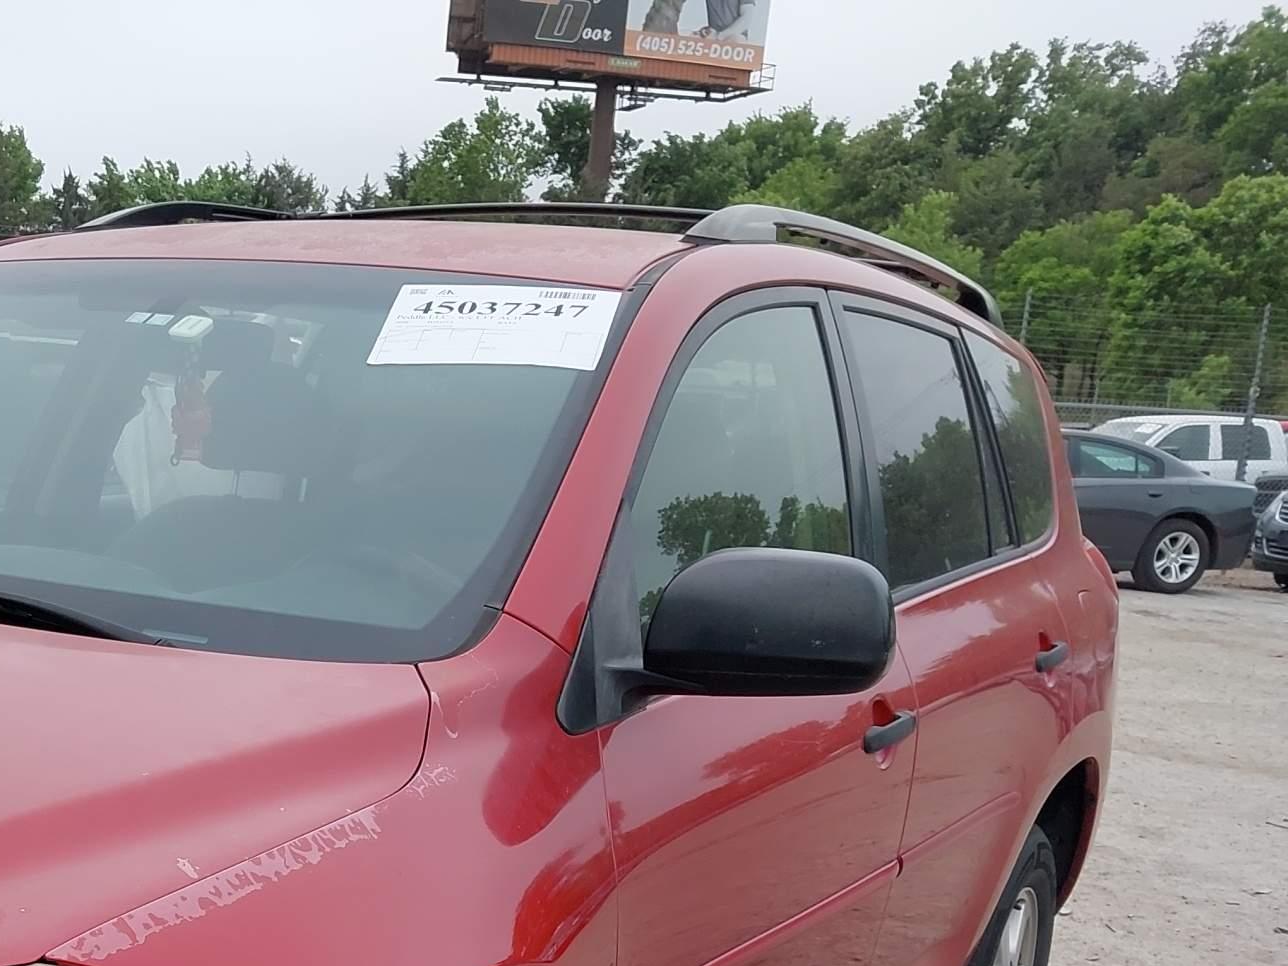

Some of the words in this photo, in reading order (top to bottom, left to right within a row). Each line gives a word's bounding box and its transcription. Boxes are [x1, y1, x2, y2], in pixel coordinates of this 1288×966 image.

[636, 34, 675, 55] (405)
[677, 40, 755, 62] 525-DOOR
[413, 300, 589, 318] 45037247
